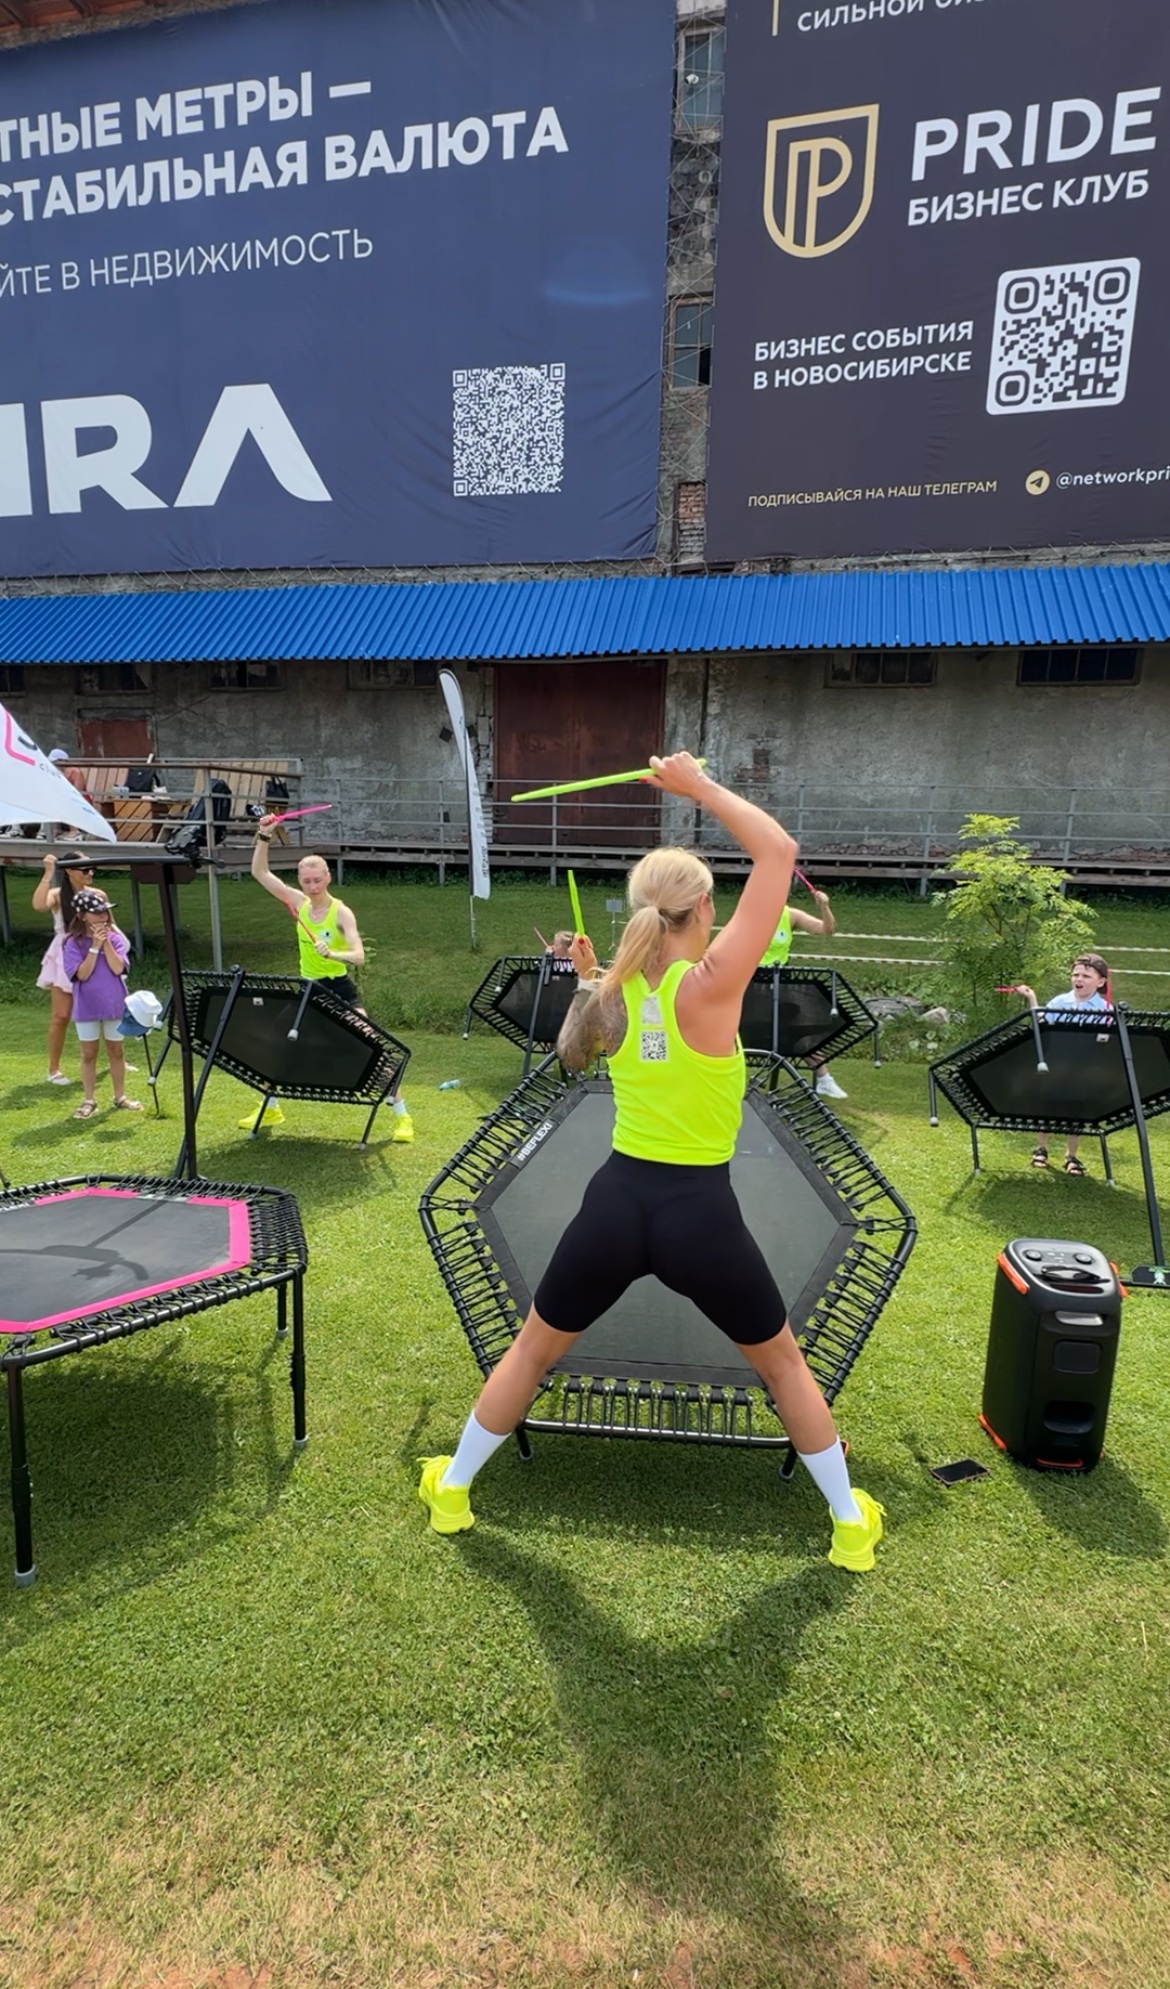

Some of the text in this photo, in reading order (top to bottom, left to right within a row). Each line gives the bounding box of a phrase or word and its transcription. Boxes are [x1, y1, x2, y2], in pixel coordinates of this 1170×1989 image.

[0, 102, 123, 163] ТНЫЕ
[135, 72, 313, 141] МЕТРЫ
[911, 87, 1162, 182] PRIDE
[325, 107, 569, 182] ВАЛЮТА
[907, 169, 1149, 227] БИЗНЕС КЛУБ
[61, 261, 80, 290] В
[90, 229, 373, 288] НЕДВИЖИМОСТЬ
[754, 321, 974, 362] БИЗНЕС СОБЫТИЯ
[753, 351, 973, 390] В НОВОСИБИРСКЕ
[748, 481, 998, 508] ПОДПИСЫВАЙСЯ НА НАШ ТЕЛЕГРАМ
[1055, 465, 1170, 490] @networkpri
[517, 1121, 553, 1161] #BEFLEXI
